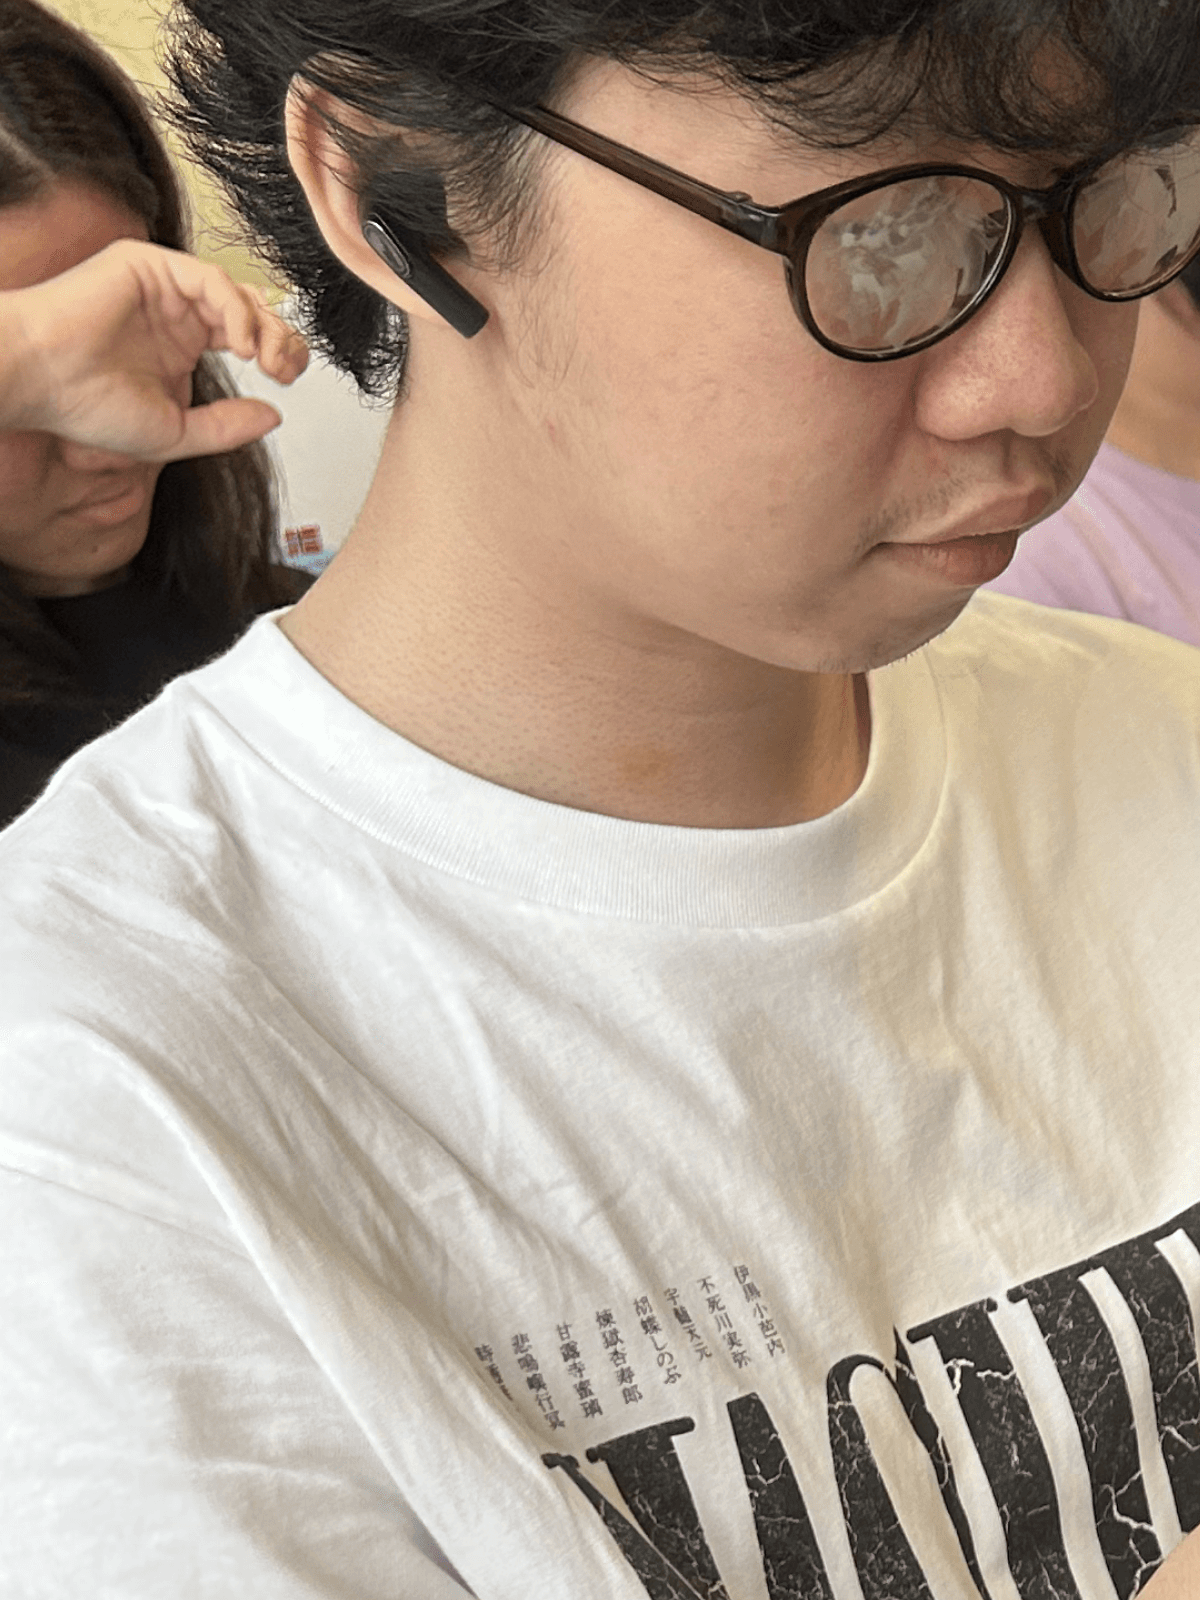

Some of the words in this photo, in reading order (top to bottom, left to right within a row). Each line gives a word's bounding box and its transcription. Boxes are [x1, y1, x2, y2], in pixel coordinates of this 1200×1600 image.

[633, 1295, 682, 1385] 胡蝶しのぶ
[696, 1275, 752, 1369] 不死川実弥
